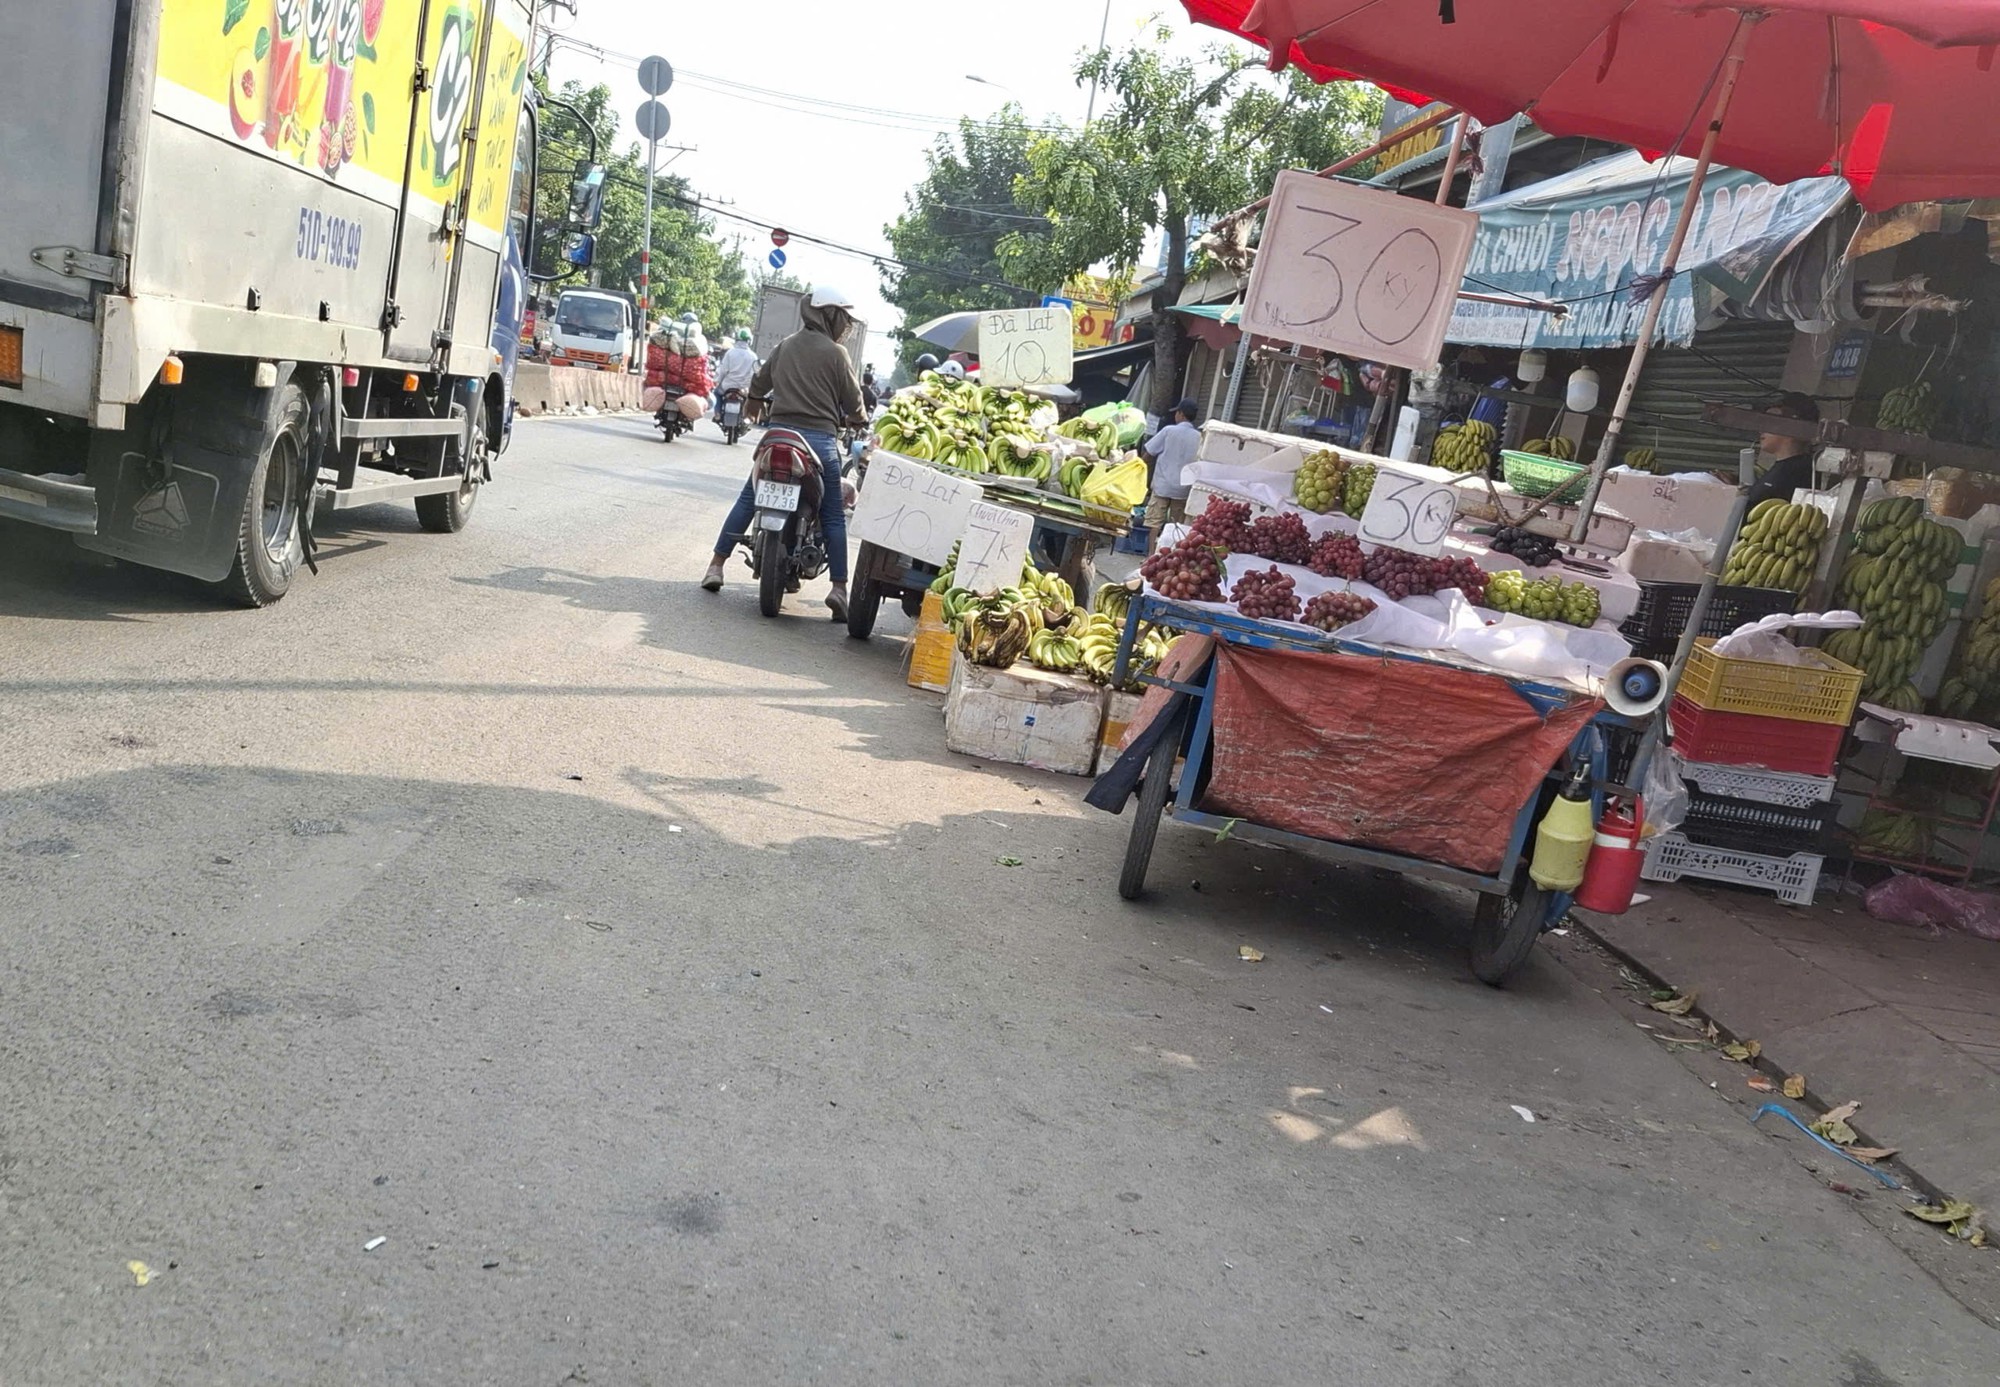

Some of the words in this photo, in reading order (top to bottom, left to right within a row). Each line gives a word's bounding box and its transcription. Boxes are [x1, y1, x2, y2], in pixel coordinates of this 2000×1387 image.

[429, 21, 474, 176] C2
[297, 206, 362, 271] 51D-198.99
[1280, 205, 1441, 346] 30
[1491, 203, 1557, 274] CHUỐI
[1556, 196, 1671, 291] NGỌC
[757, 494, 796, 509] 017.36
[763, 482, 794, 497] 59-V3
[1362, 470, 1456, 545] 30
